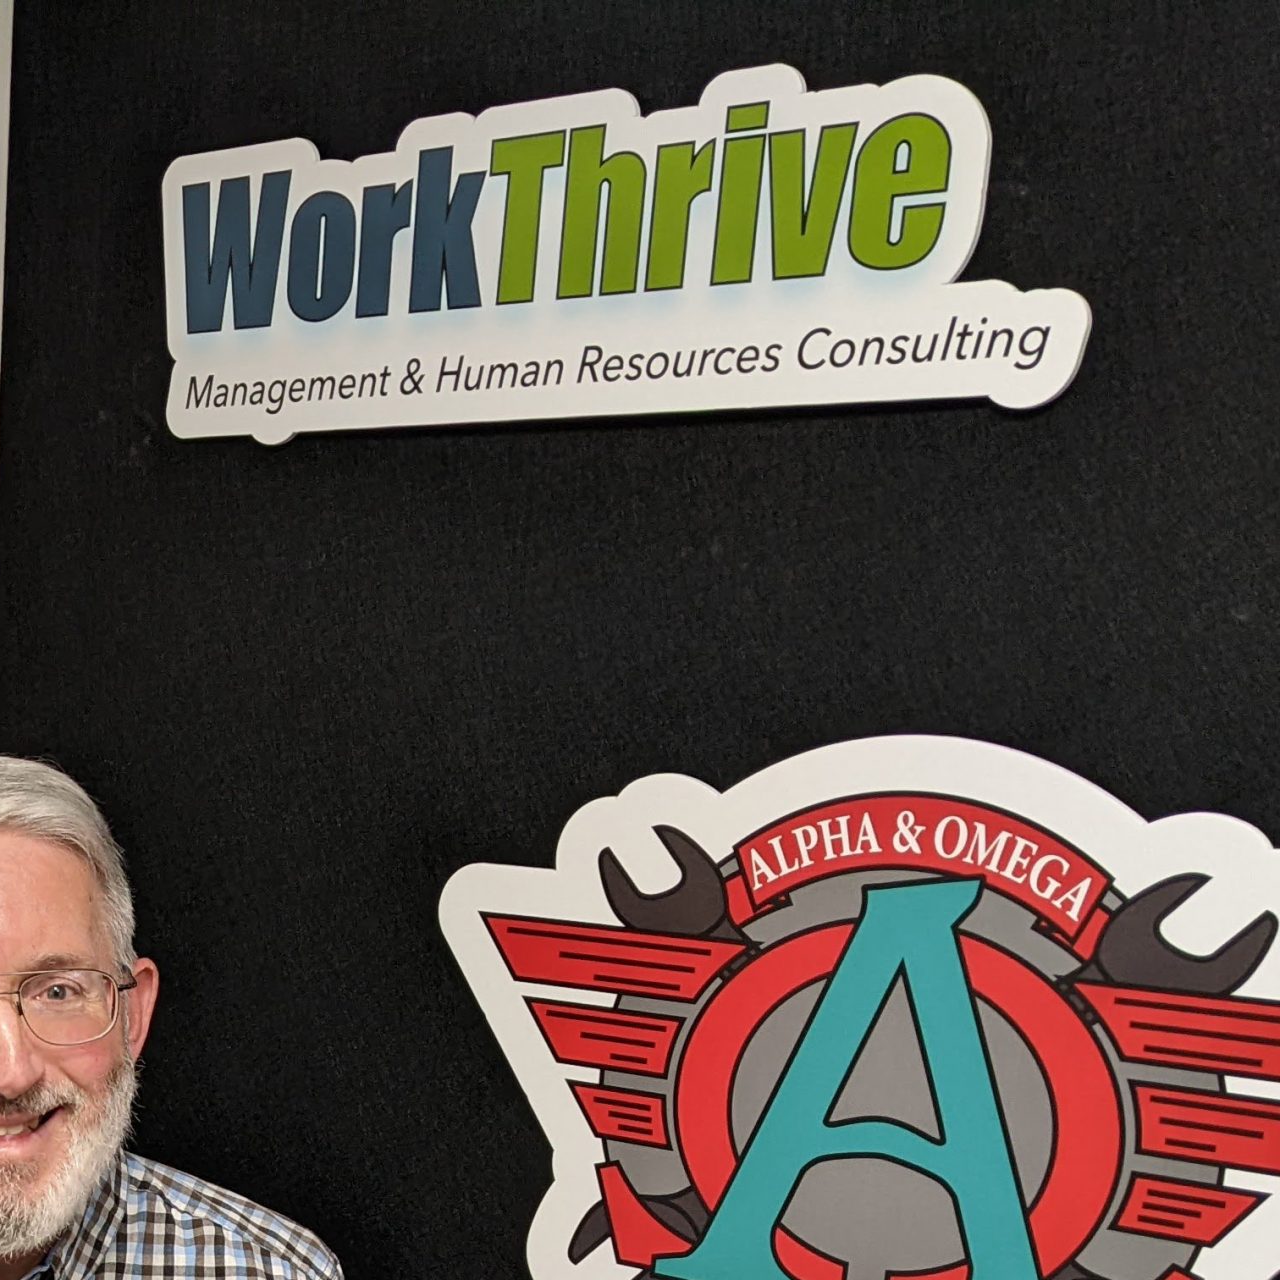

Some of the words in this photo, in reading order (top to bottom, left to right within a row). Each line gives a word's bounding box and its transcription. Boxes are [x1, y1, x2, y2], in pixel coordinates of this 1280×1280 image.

[181, 101, 952, 335] WorkThrive
[185, 365, 391, 414] Management
[399, 357, 425, 395] &
[435, 355, 564, 393] Human
[576, 345, 783, 383] Resources
[797, 316, 1051, 370] Consulting
[746, 811, 883, 891] ALPHA
[892, 810, 926, 854] &
[933, 814, 1093, 922] OMEGA
